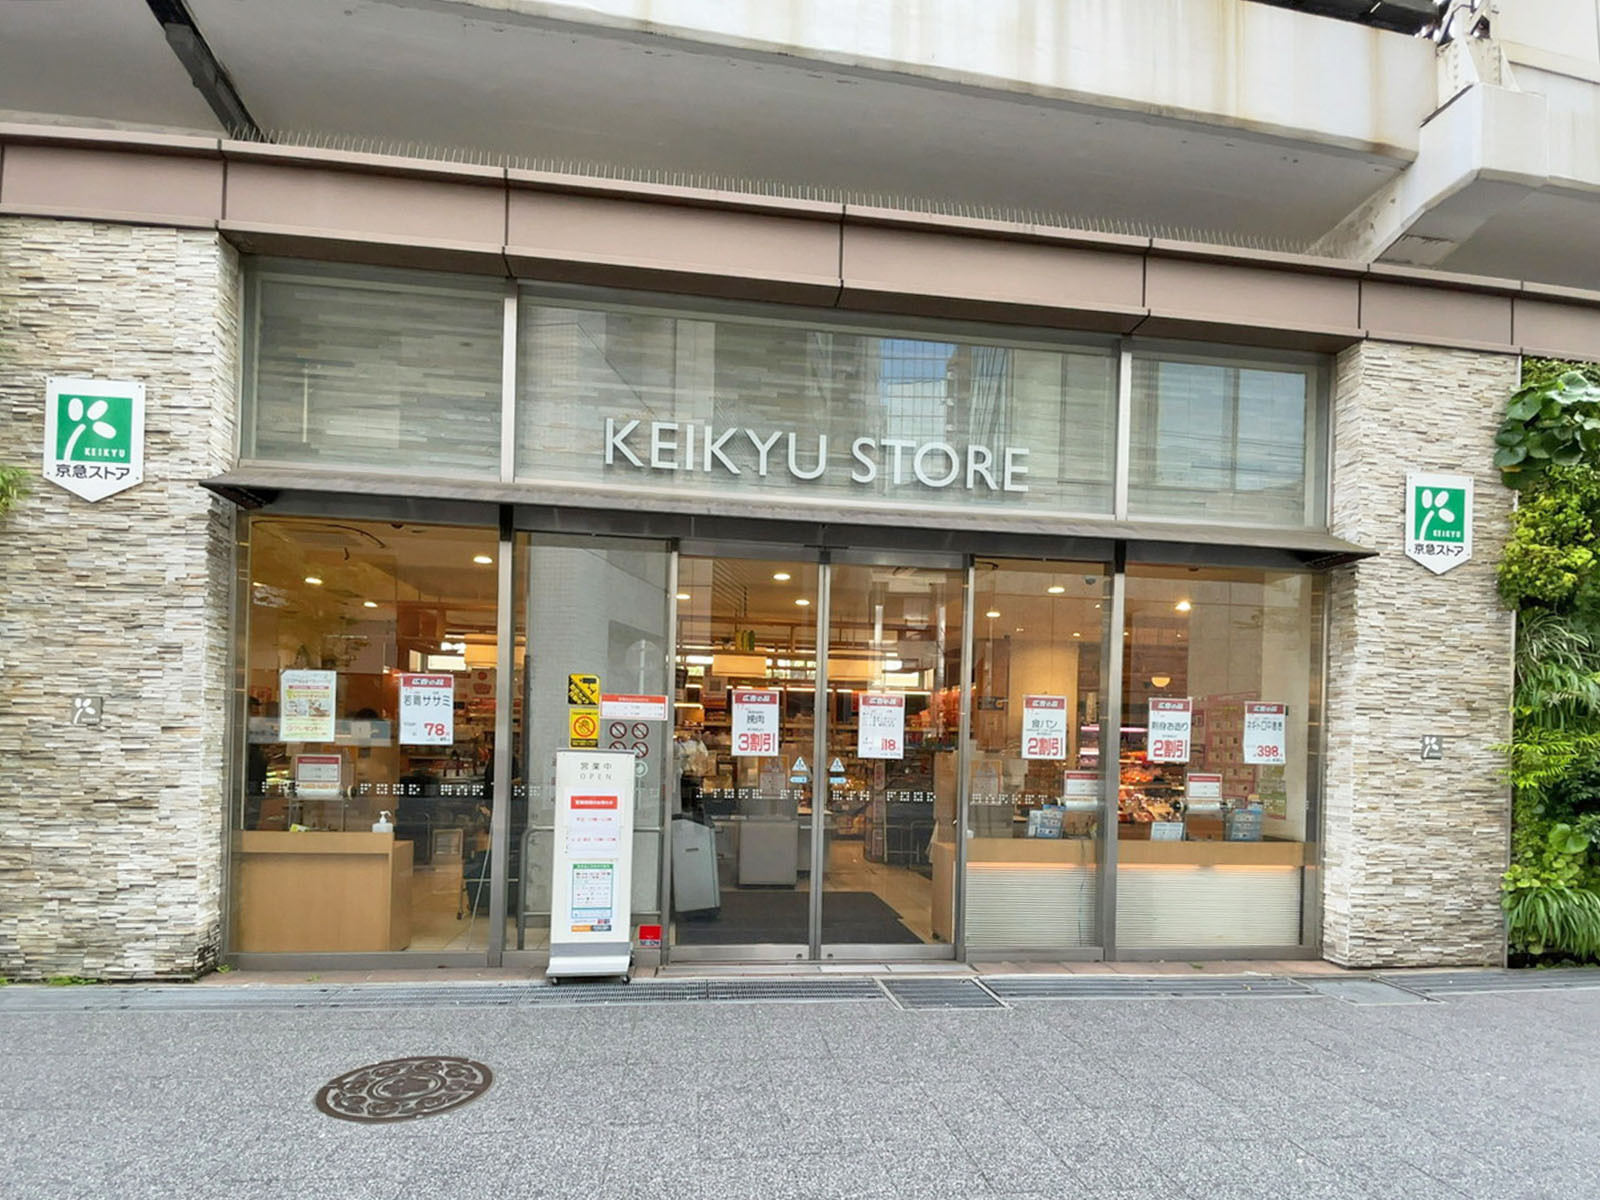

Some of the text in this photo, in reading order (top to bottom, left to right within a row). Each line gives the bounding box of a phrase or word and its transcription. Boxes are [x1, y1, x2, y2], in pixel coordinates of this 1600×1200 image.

[84, 447, 126, 458] KEIKYU
[604, 417, 1030, 493] KEIKYU STORE
[55, 463, 131, 480] 京急ストア
[1432, 529, 1461, 539] KEIKYU
[1413, 543, 1464, 557] 京急ストア
[424, 722, 446, 736] 78
[1031, 718, 1058, 729] 食パン
[738, 732, 776, 752] 3割引
[1028, 737, 1063, 756] 2割引
[1153, 739, 1188, 758] 2割引
[1257, 745, 1279, 757] 398
[580, 762, 612, 770] 営業中
[360, 783, 421, 796] FOOD
